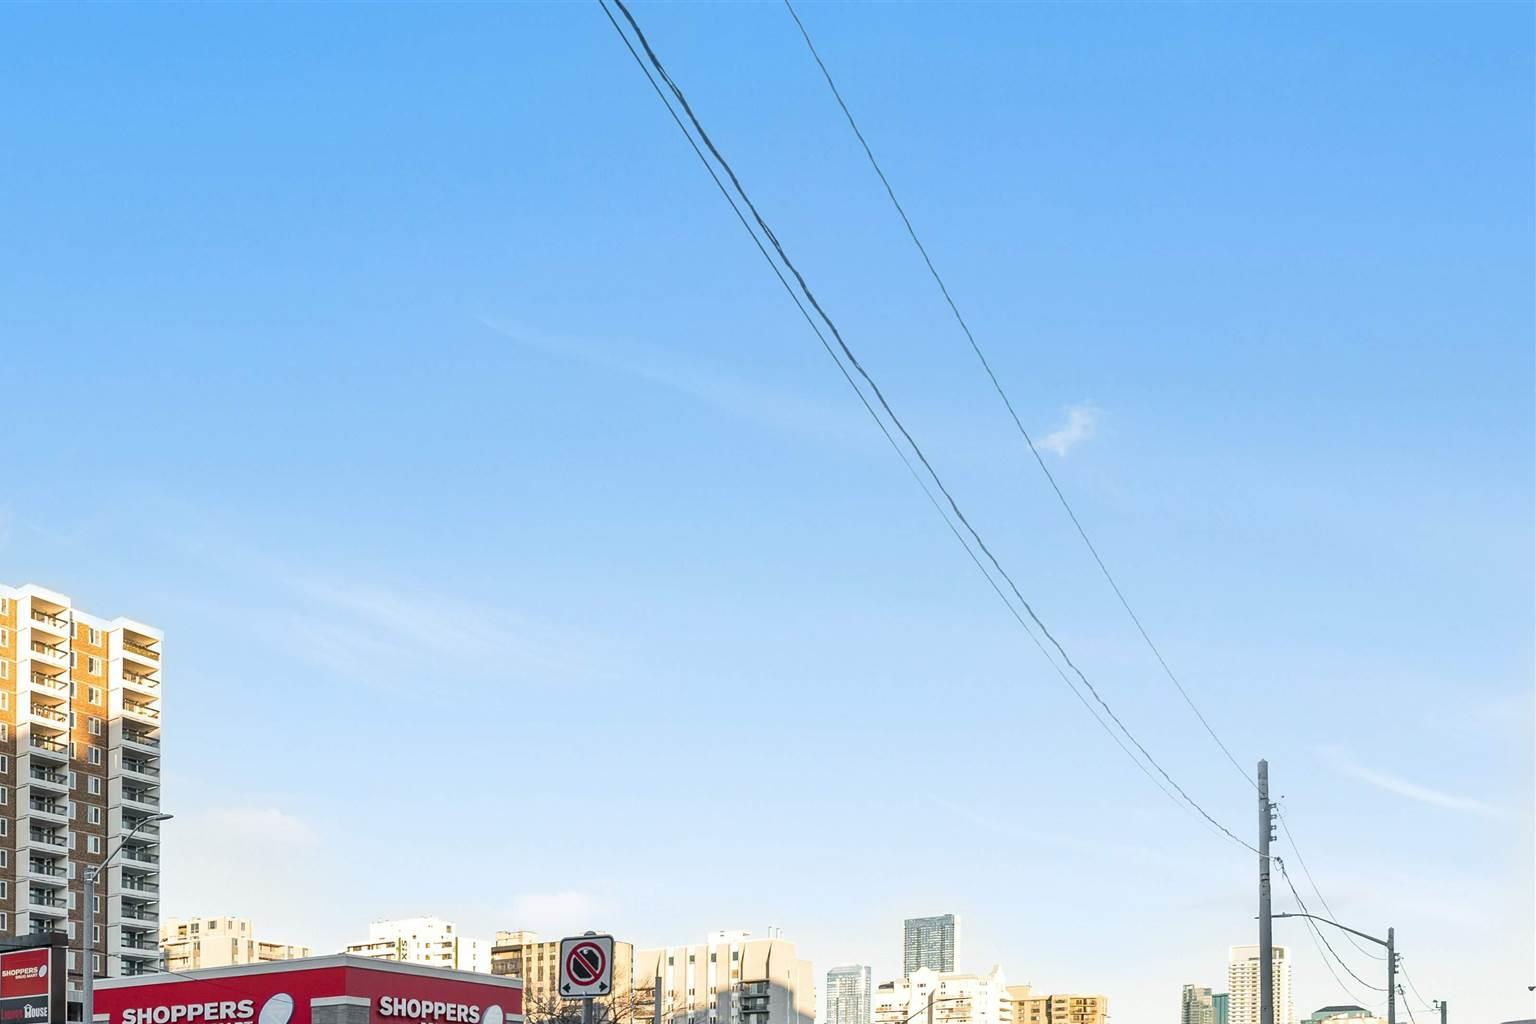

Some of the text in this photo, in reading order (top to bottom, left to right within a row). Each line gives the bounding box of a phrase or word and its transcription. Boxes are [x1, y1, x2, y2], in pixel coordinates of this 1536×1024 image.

[2, 967, 39, 977] SHOPPERS
[24, 1004, 48, 1018] HOUSE
[379, 995, 480, 1024] SHOPPERS
